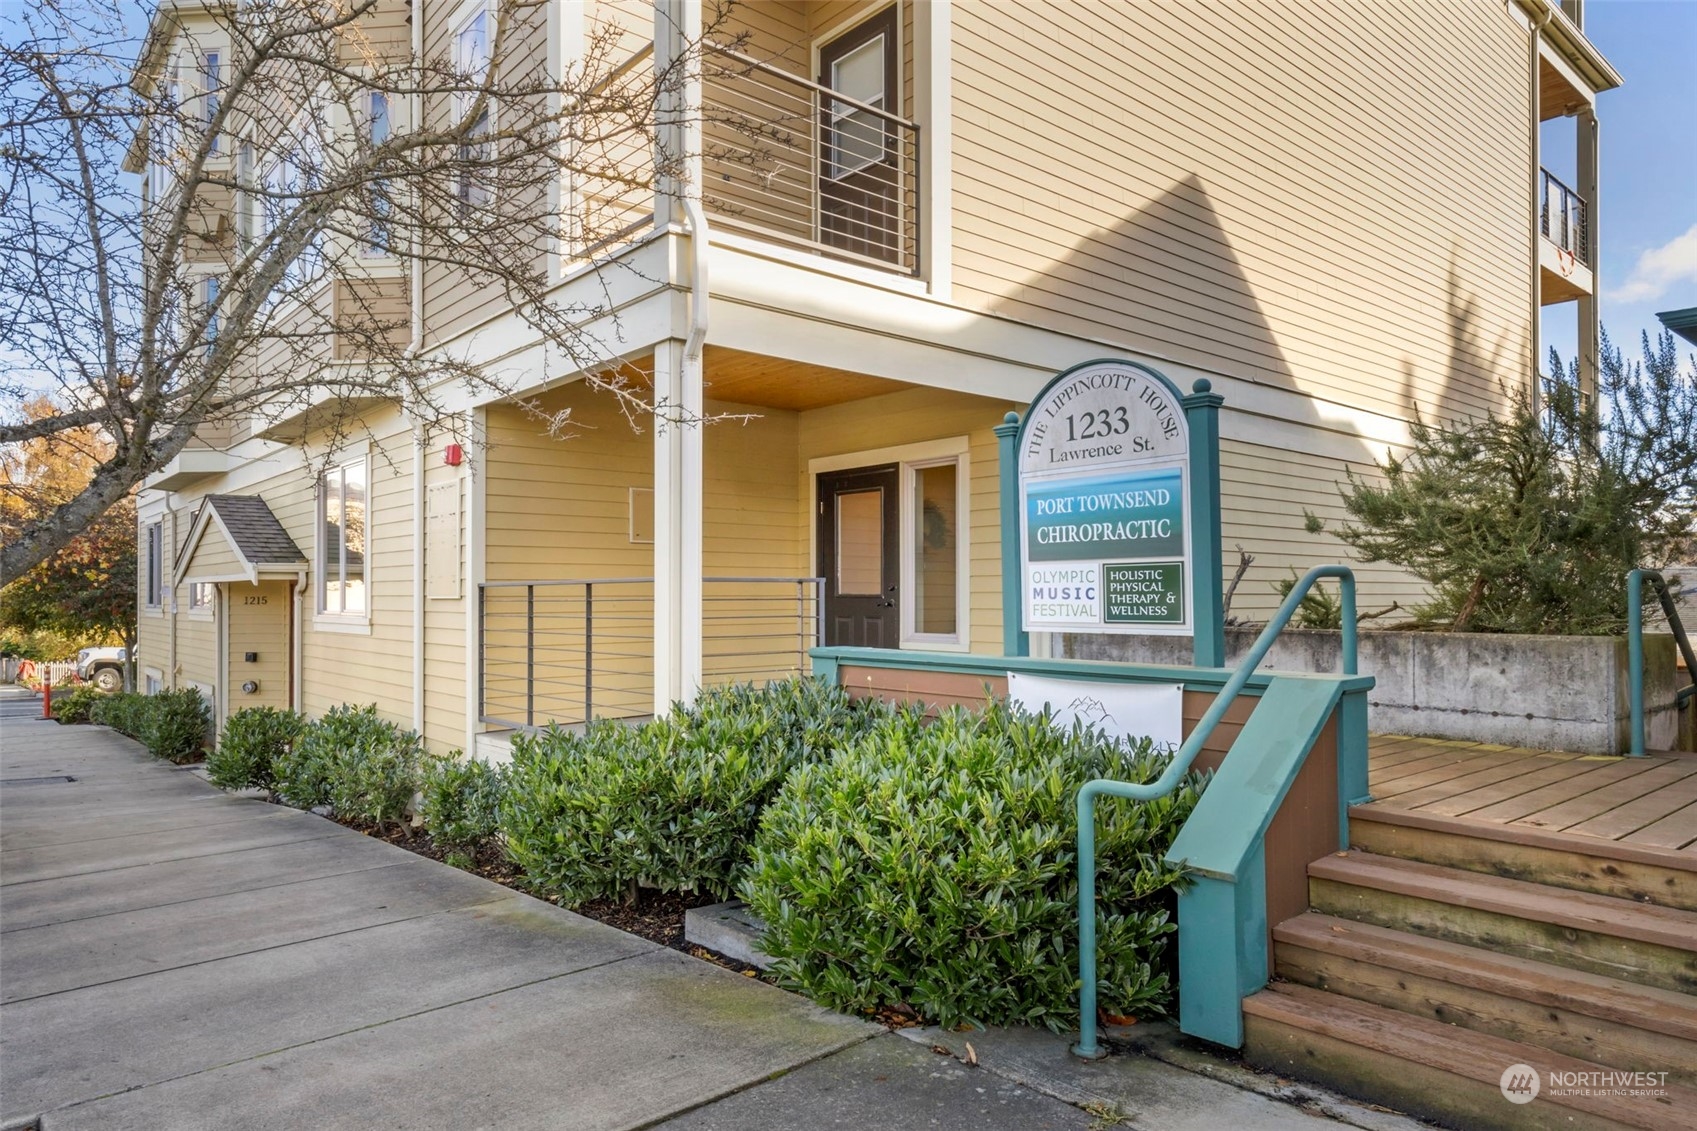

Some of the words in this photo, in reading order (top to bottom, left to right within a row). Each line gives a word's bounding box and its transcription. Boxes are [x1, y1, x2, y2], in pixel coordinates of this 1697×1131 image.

[1028, 420, 1048, 458] THE
[1047, 373, 1136, 417] LIPPINCOTT
[1139, 385, 1179, 440] HOUSE
[1065, 406, 1130, 442] 1233
[1049, 443, 1123, 463] Lawrence
[1132, 436, 1155, 453] St.
[1036, 496, 1075, 516] PORT
[1077, 488, 1170, 513] TOWNSEND
[1037, 518, 1171, 544] CHIROPRACTIC
[1032, 569, 1095, 584] OLYMPIC
[1110, 569, 1163, 581] HOLISTIC
[1032, 586, 1096, 600] MUSIC
[1110, 581, 1165, 593] PHYSICAL
[244, 596, 268, 605] 1215
[1110, 593, 1161, 605] THERAPY
[1166, 592, 1176, 604] &
[1032, 602, 1097, 618] FESTIVAL
[1110, 605, 1168, 617] WELLNESS
